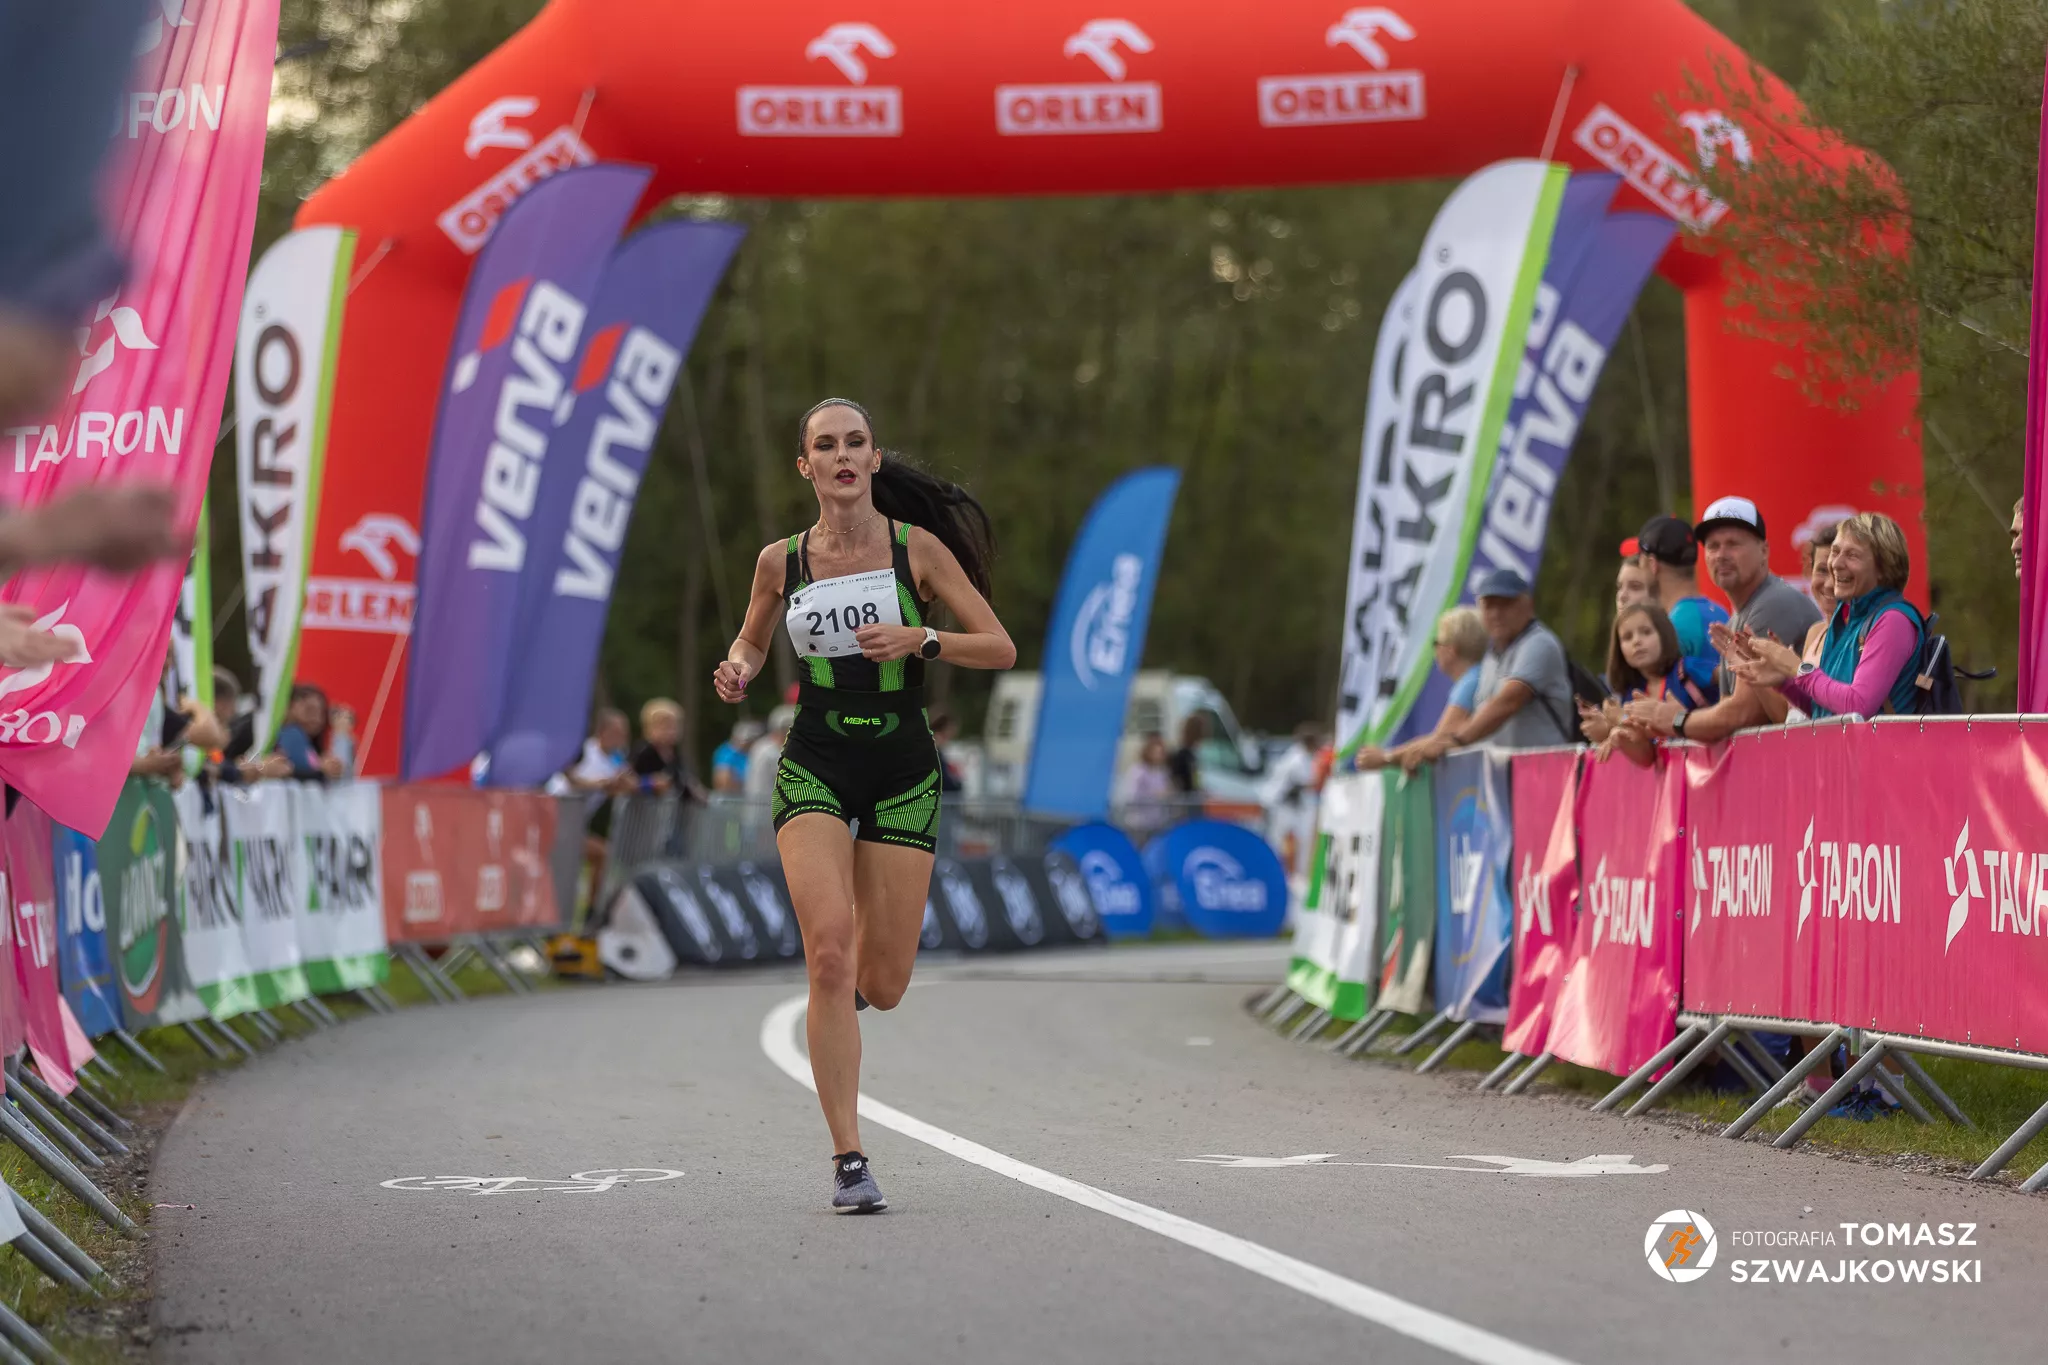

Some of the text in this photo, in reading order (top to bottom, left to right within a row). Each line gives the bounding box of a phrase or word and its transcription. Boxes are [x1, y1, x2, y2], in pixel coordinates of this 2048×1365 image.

[749, 97, 888, 126] ORLEN
[1008, 95, 1148, 126] ORLEN
[1268, 79, 1415, 119] ORLEN
[467, 279, 588, 572] verva
[554, 326, 684, 602] verva
[303, 591, 416, 620] RLEN
[806, 602, 880, 636] 2108
[1707, 843, 1773, 918] TAURON
